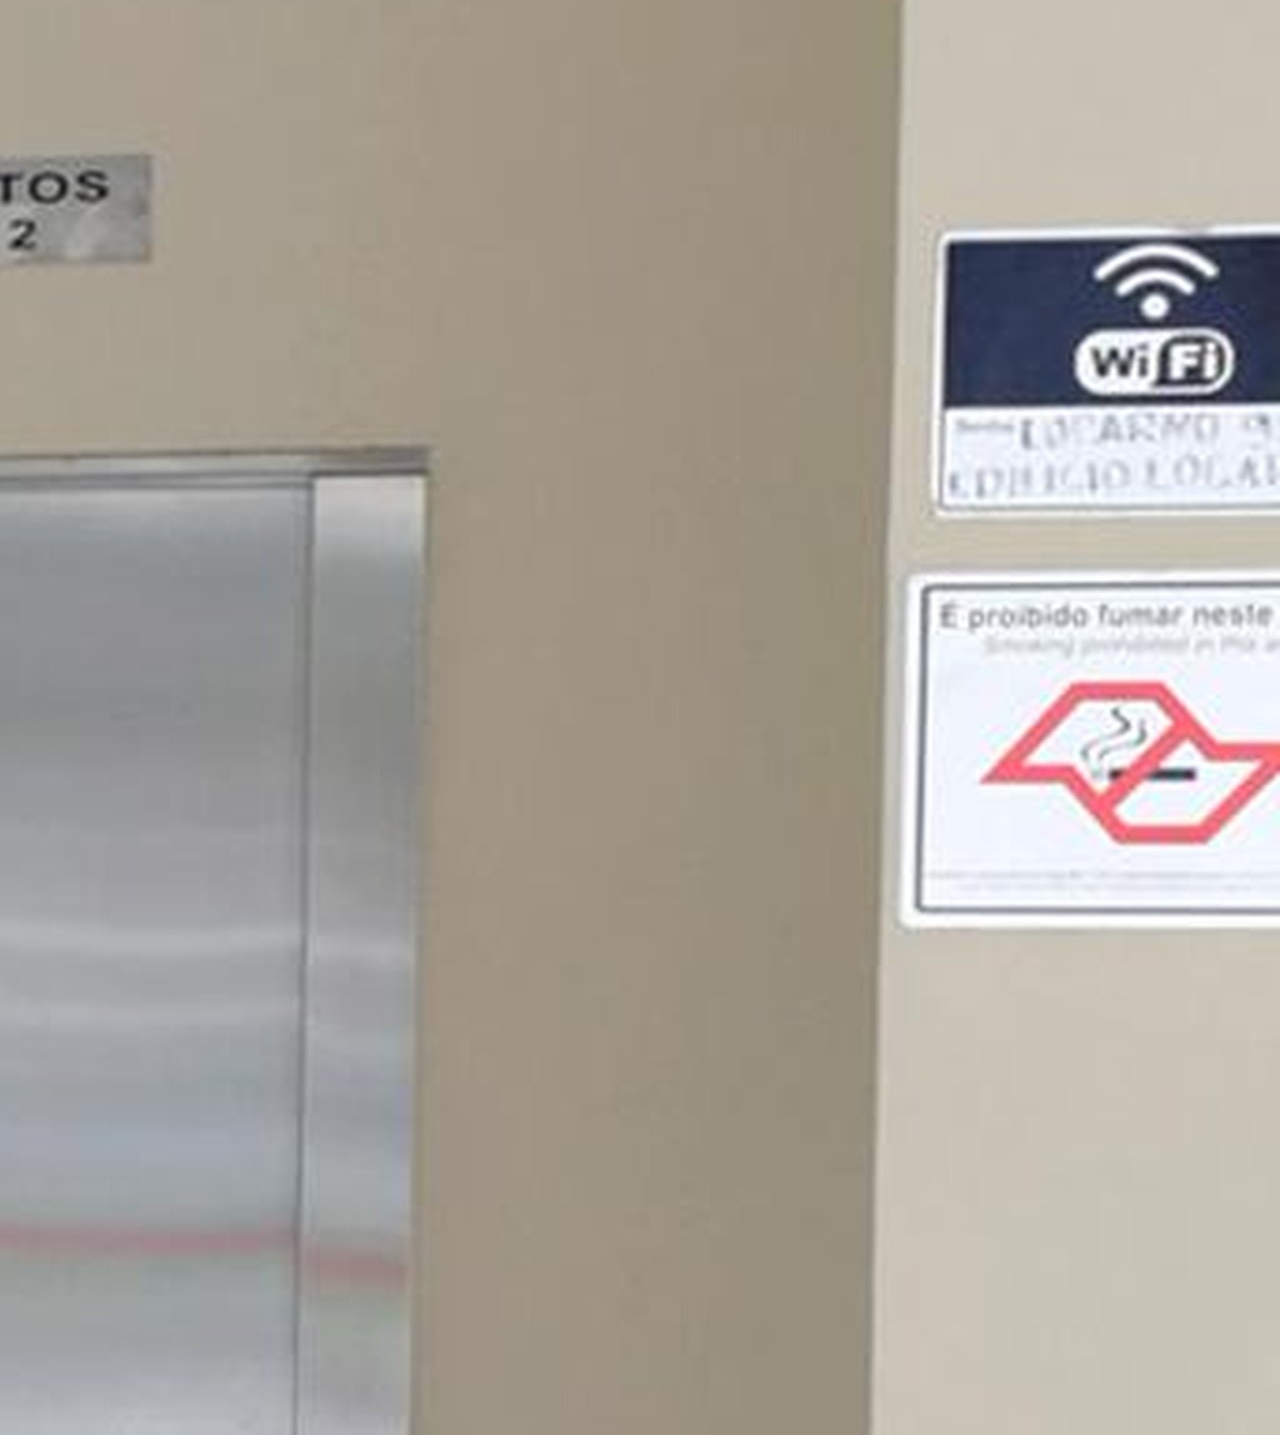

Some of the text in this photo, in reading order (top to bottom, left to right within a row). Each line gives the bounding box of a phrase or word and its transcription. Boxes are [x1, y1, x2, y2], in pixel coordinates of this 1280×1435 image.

[8, 219, 39, 251] 2
[940, 601, 1274, 630] É proibido fumar neste
